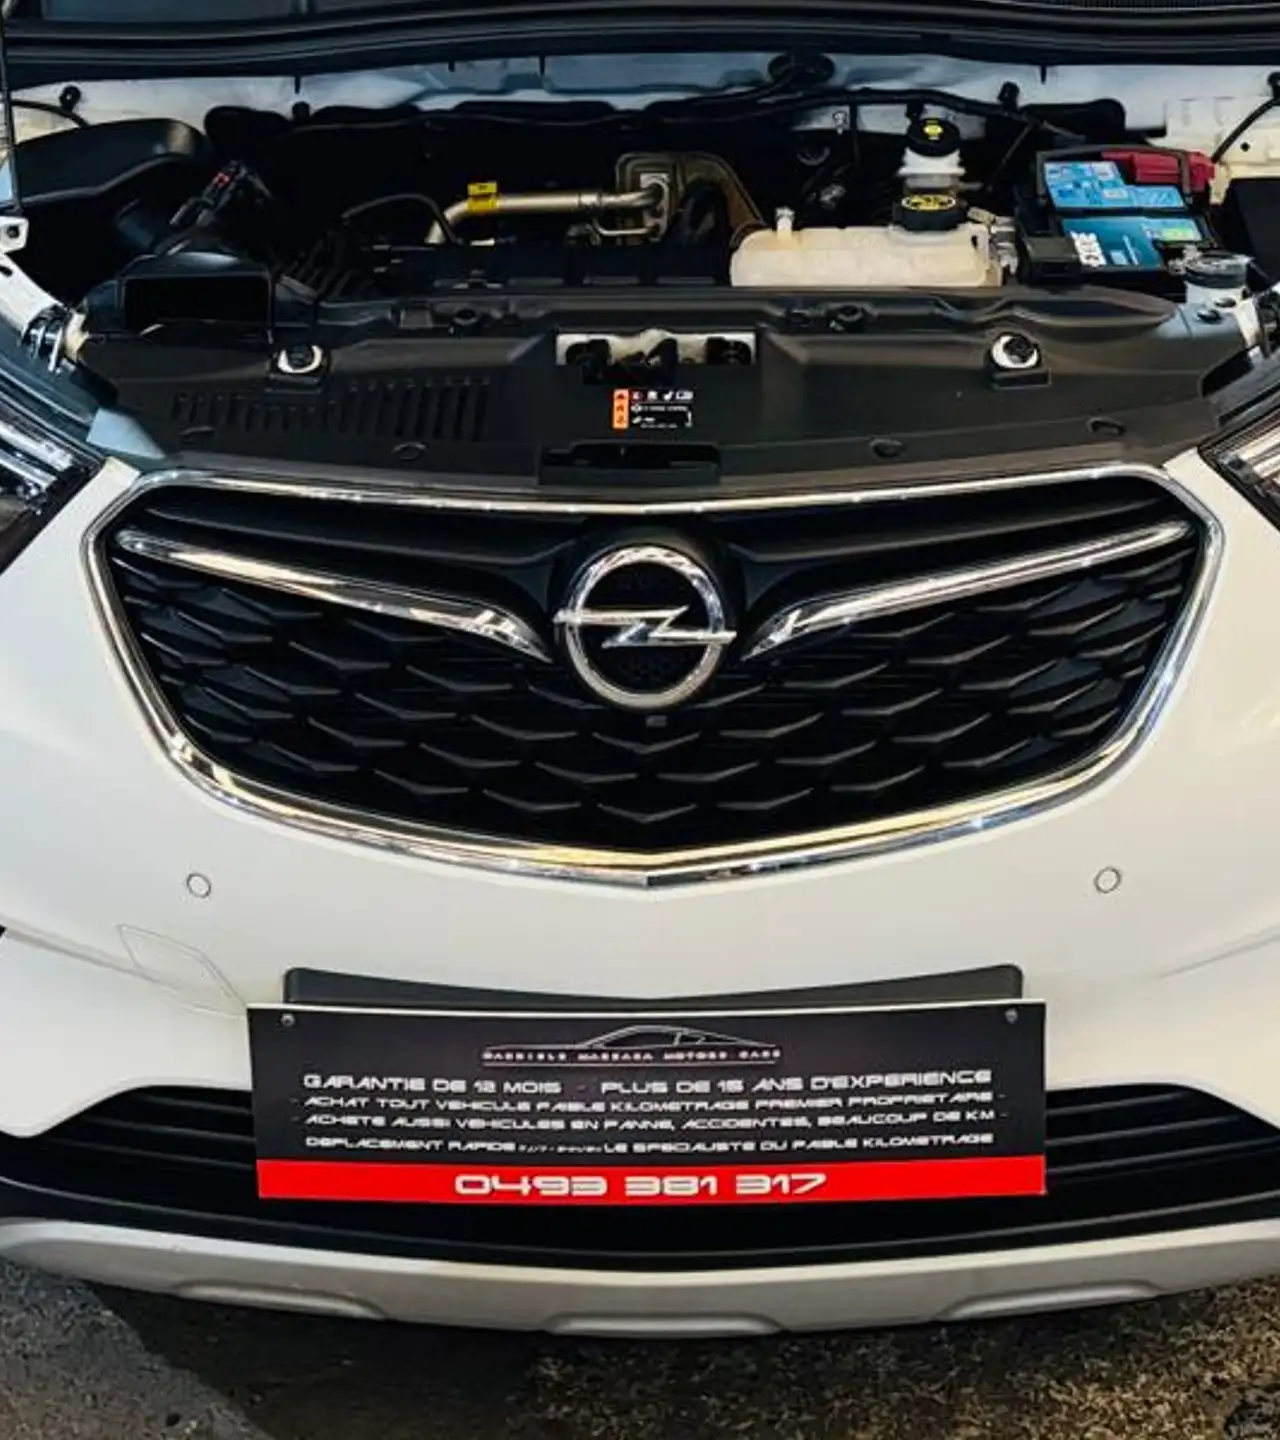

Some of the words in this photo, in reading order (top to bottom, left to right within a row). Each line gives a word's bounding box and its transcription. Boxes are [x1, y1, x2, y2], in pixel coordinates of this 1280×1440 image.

[303, 1074, 426, 1092] GARANTIE
[432, 1078, 467, 1093] DE
[503, 1080, 562, 1094] MOIS
[601, 1081, 668, 1094] PLUS
[676, 1079, 711, 1094] DE
[751, 1076, 803, 1092] ANS
[304, 1096, 370, 1109] ACHAT
[375, 1097, 430, 1110] TOUT
[455, 1174, 609, 1196] 0493
[624, 1174, 718, 1196] 381
[734, 1172, 828, 1196] 317
